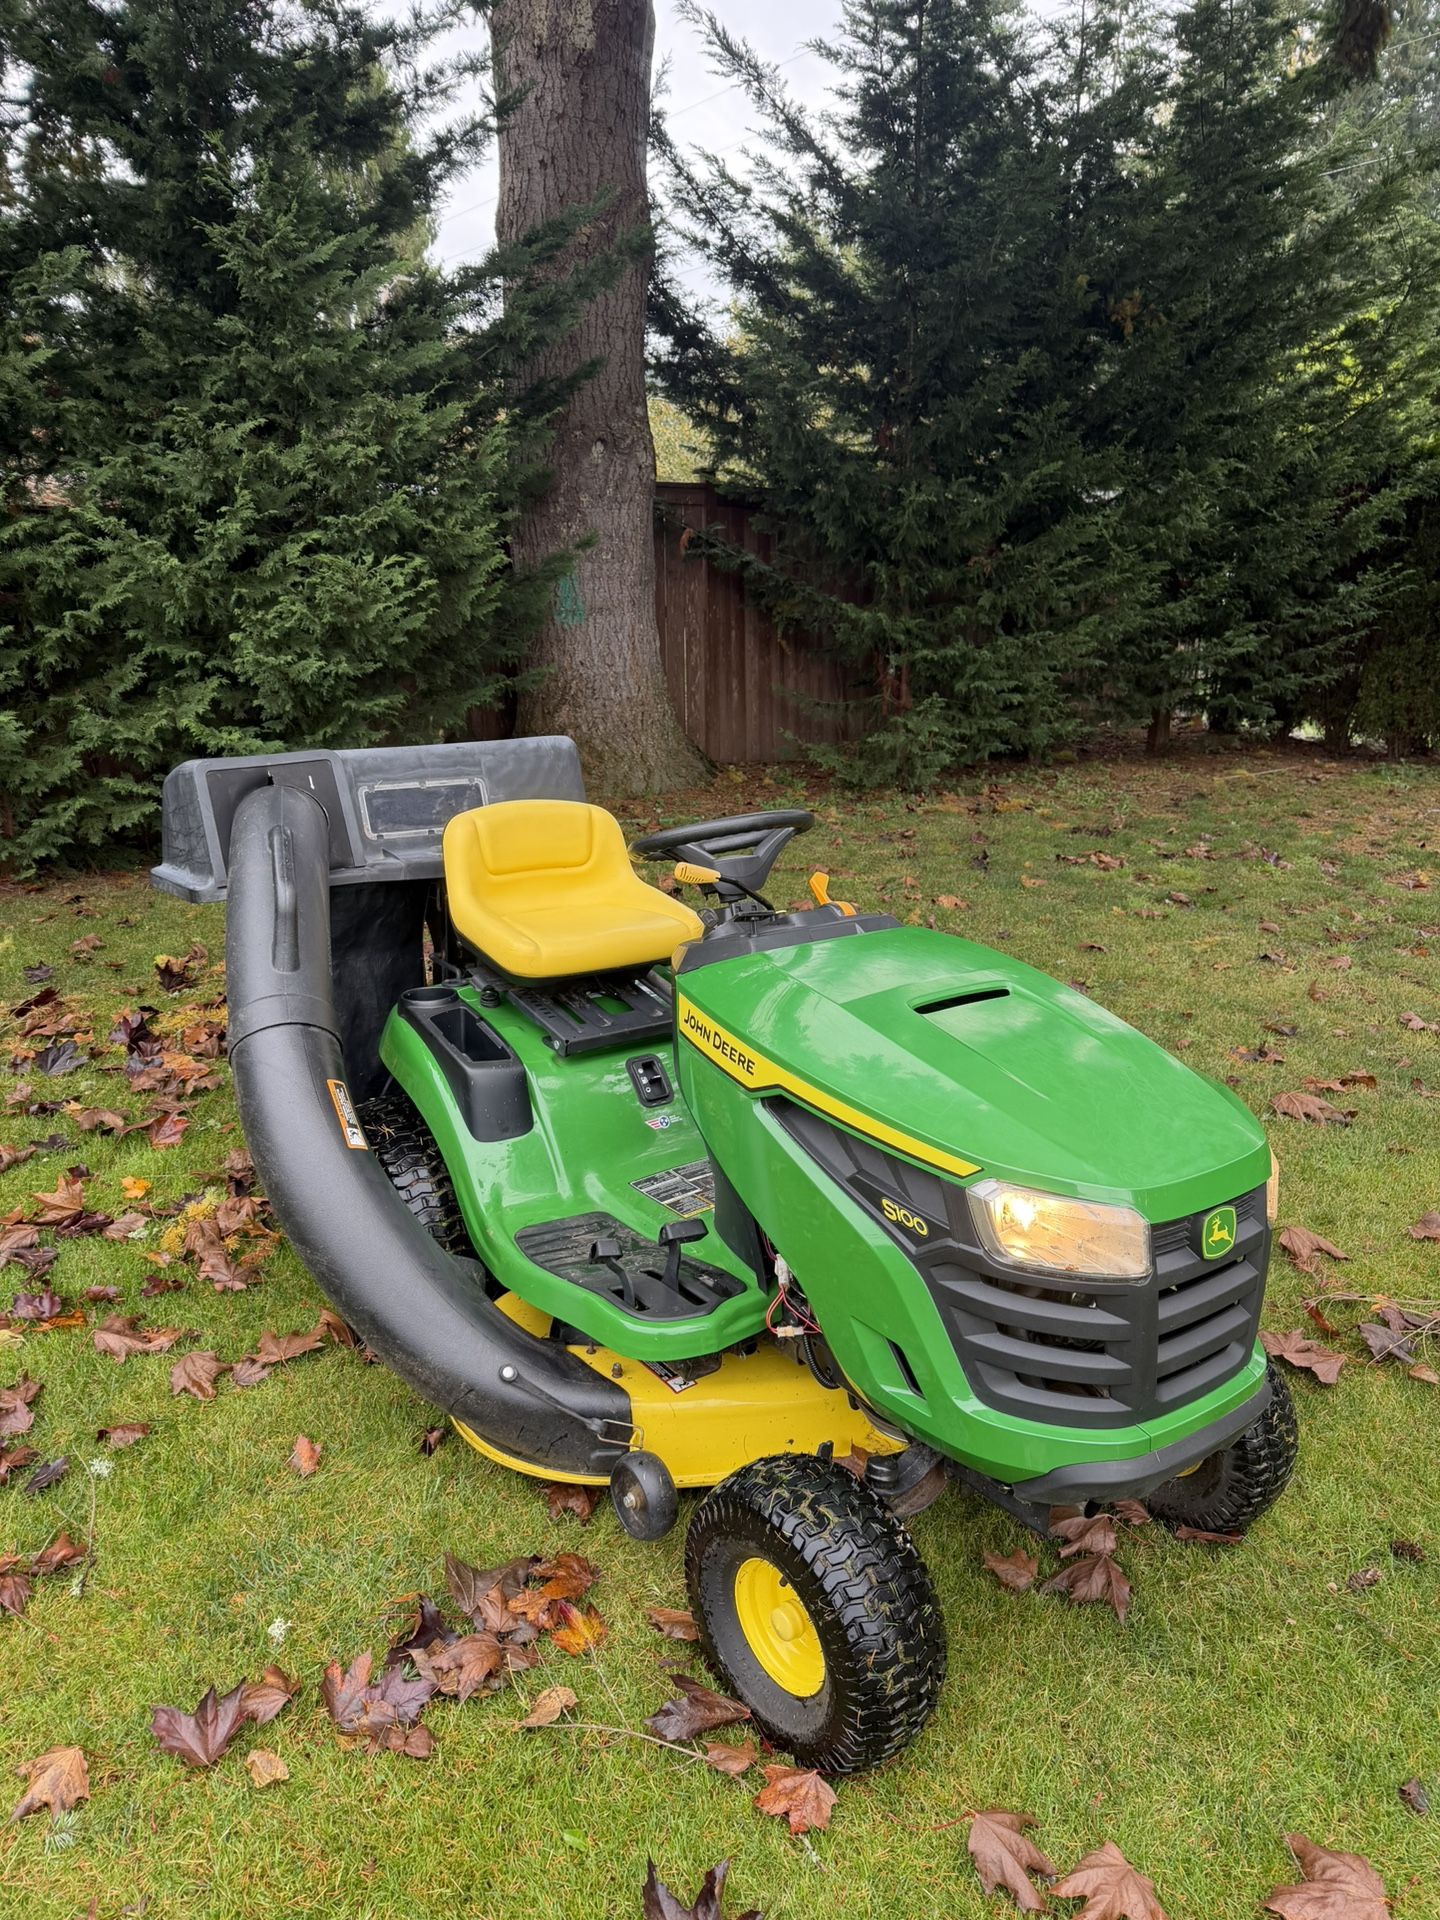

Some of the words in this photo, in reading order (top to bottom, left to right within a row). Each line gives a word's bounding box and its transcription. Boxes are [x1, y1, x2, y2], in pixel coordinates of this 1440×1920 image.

[683, 1009, 711, 1043] JOHN
[712, 1031, 756, 1076] DEERE
[881, 1197, 929, 1236] S100
